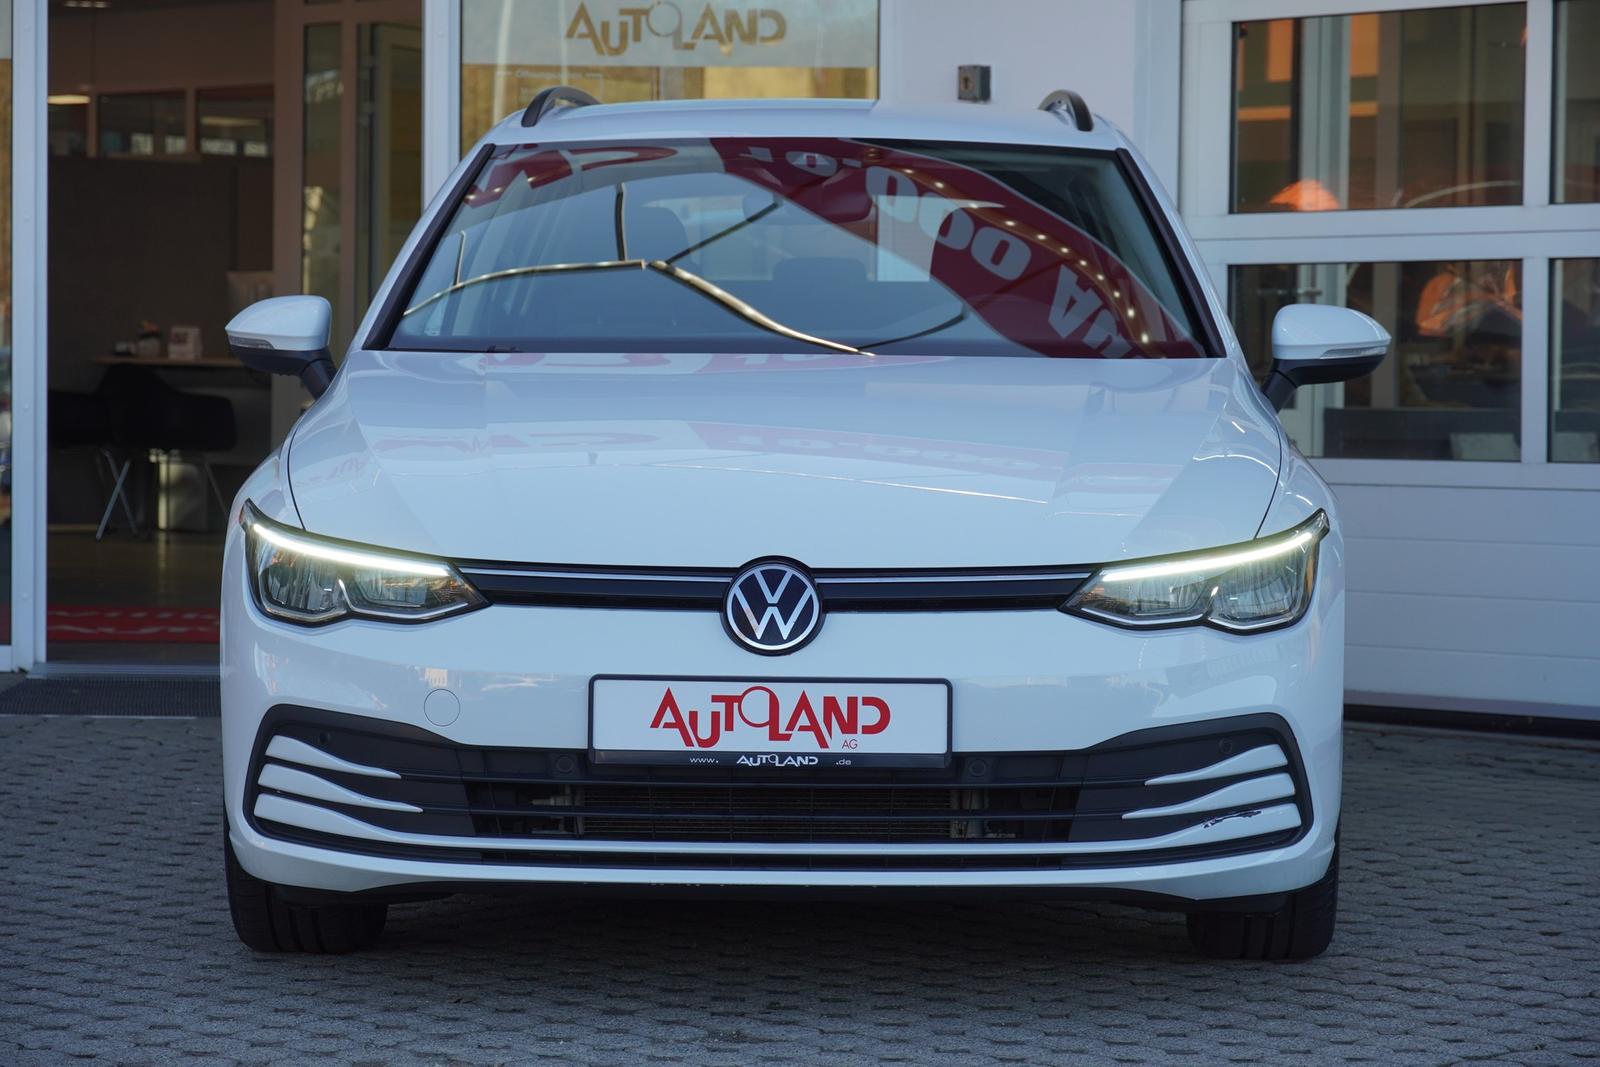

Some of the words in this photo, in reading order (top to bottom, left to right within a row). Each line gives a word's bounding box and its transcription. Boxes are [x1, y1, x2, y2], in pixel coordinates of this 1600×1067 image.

[566, 1, 786, 56] AUTOLAND
[732, 565, 814, 641] VW
[650, 686, 891, 749] AUTOLAND
[842, 738, 858, 749] AG
[736, 753, 818, 767] AUTOLAND
[835, 758, 852, 766] .de
